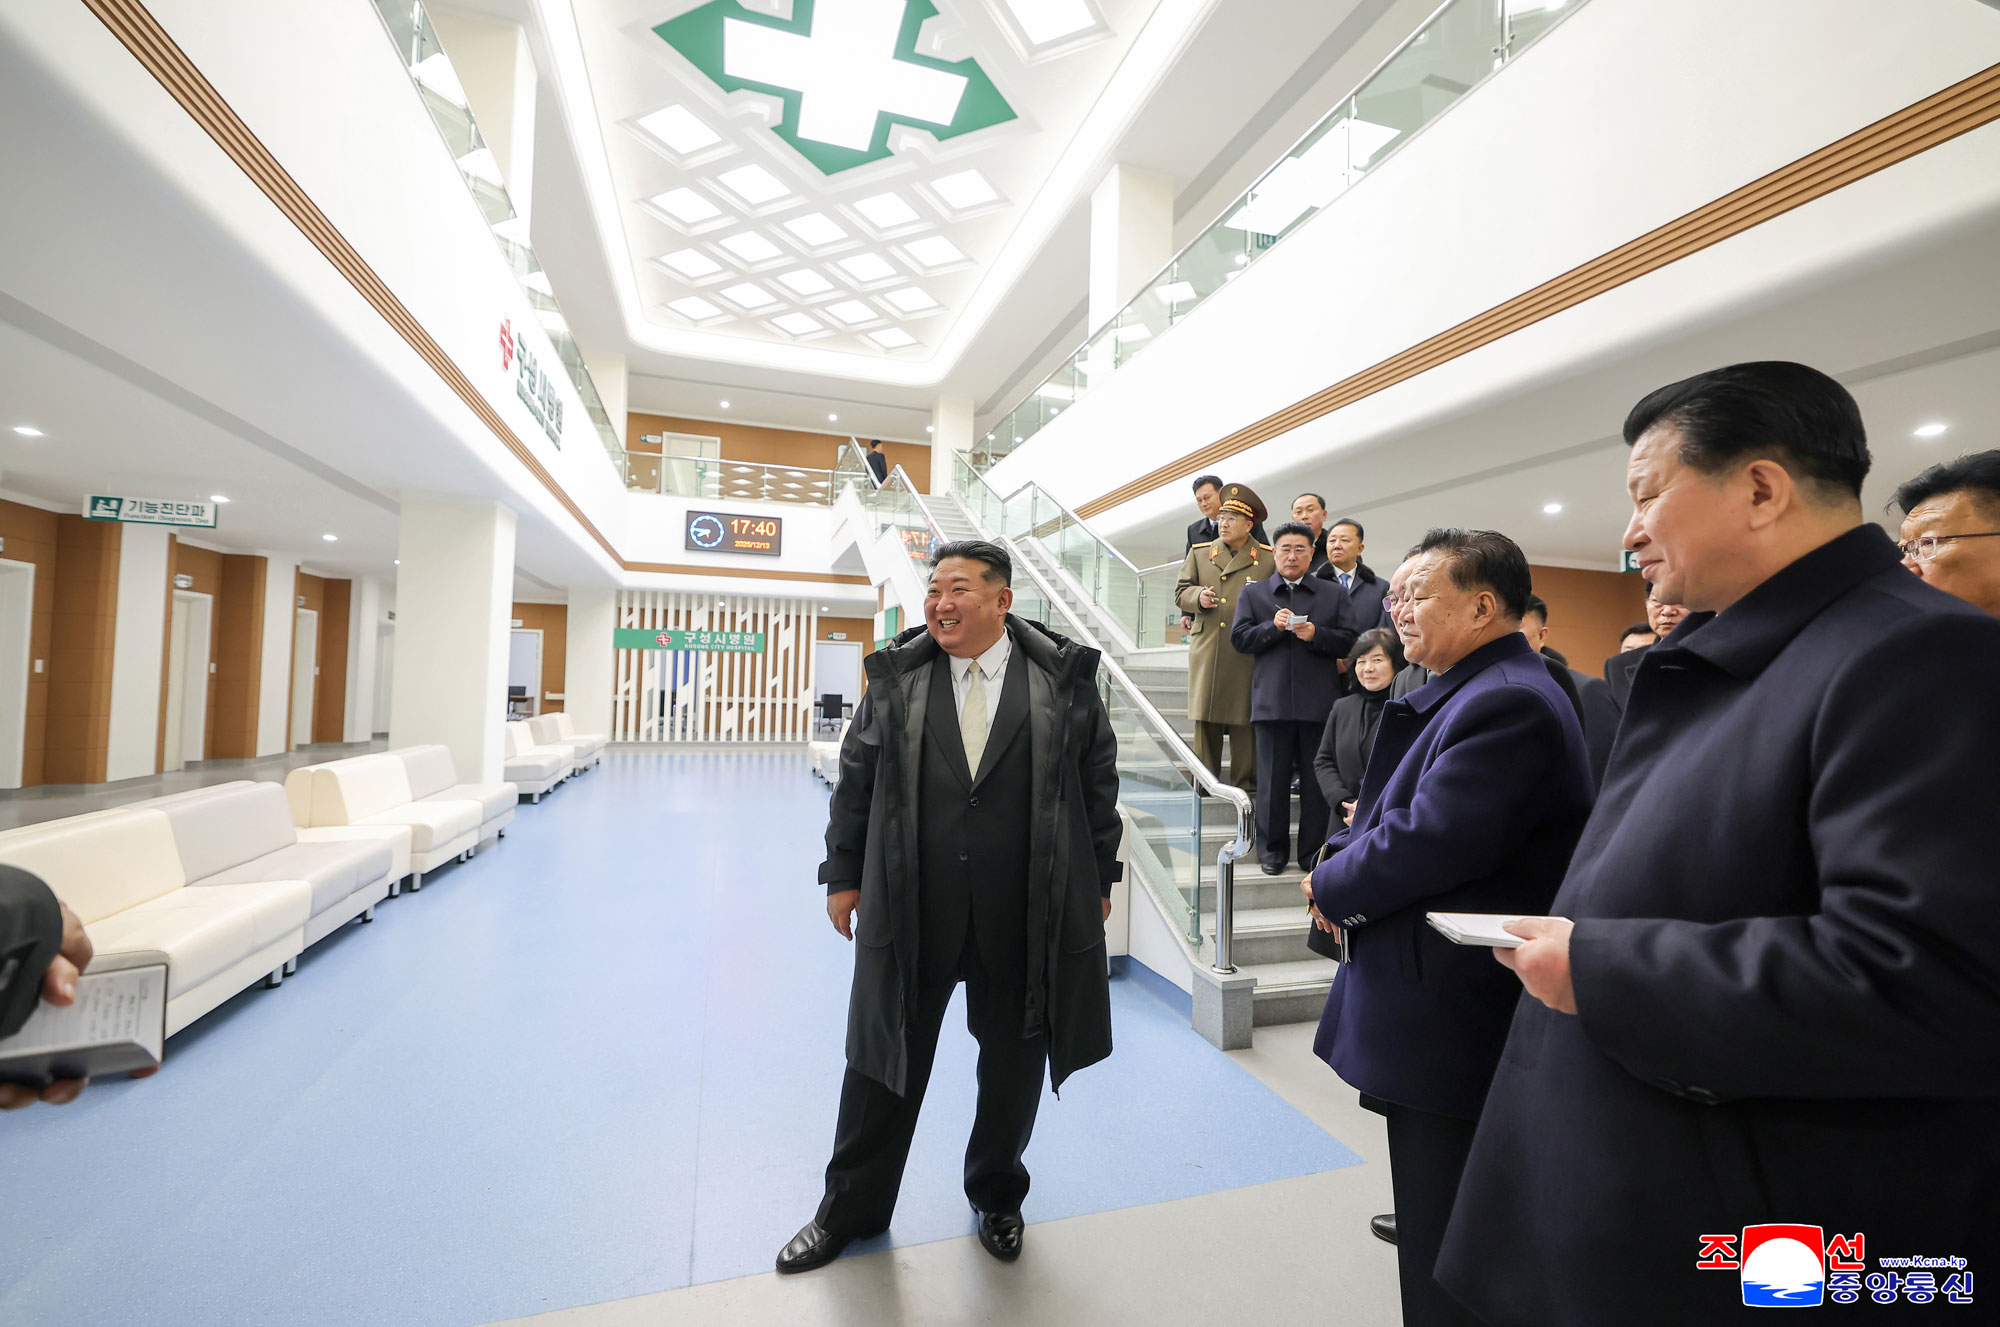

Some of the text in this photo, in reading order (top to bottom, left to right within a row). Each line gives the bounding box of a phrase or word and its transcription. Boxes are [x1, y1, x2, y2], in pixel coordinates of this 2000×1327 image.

[517, 332, 563, 435] 구성시병원
[128, 500, 205, 517] 기능진단과
[730, 518, 777, 537] 17:40
[734, 540, 771, 550] 2025/12/13
[684, 631, 755, 646] 구성시병원
[711, 643, 725, 651] CITY
[726, 644, 755, 652] HOSPITAL
